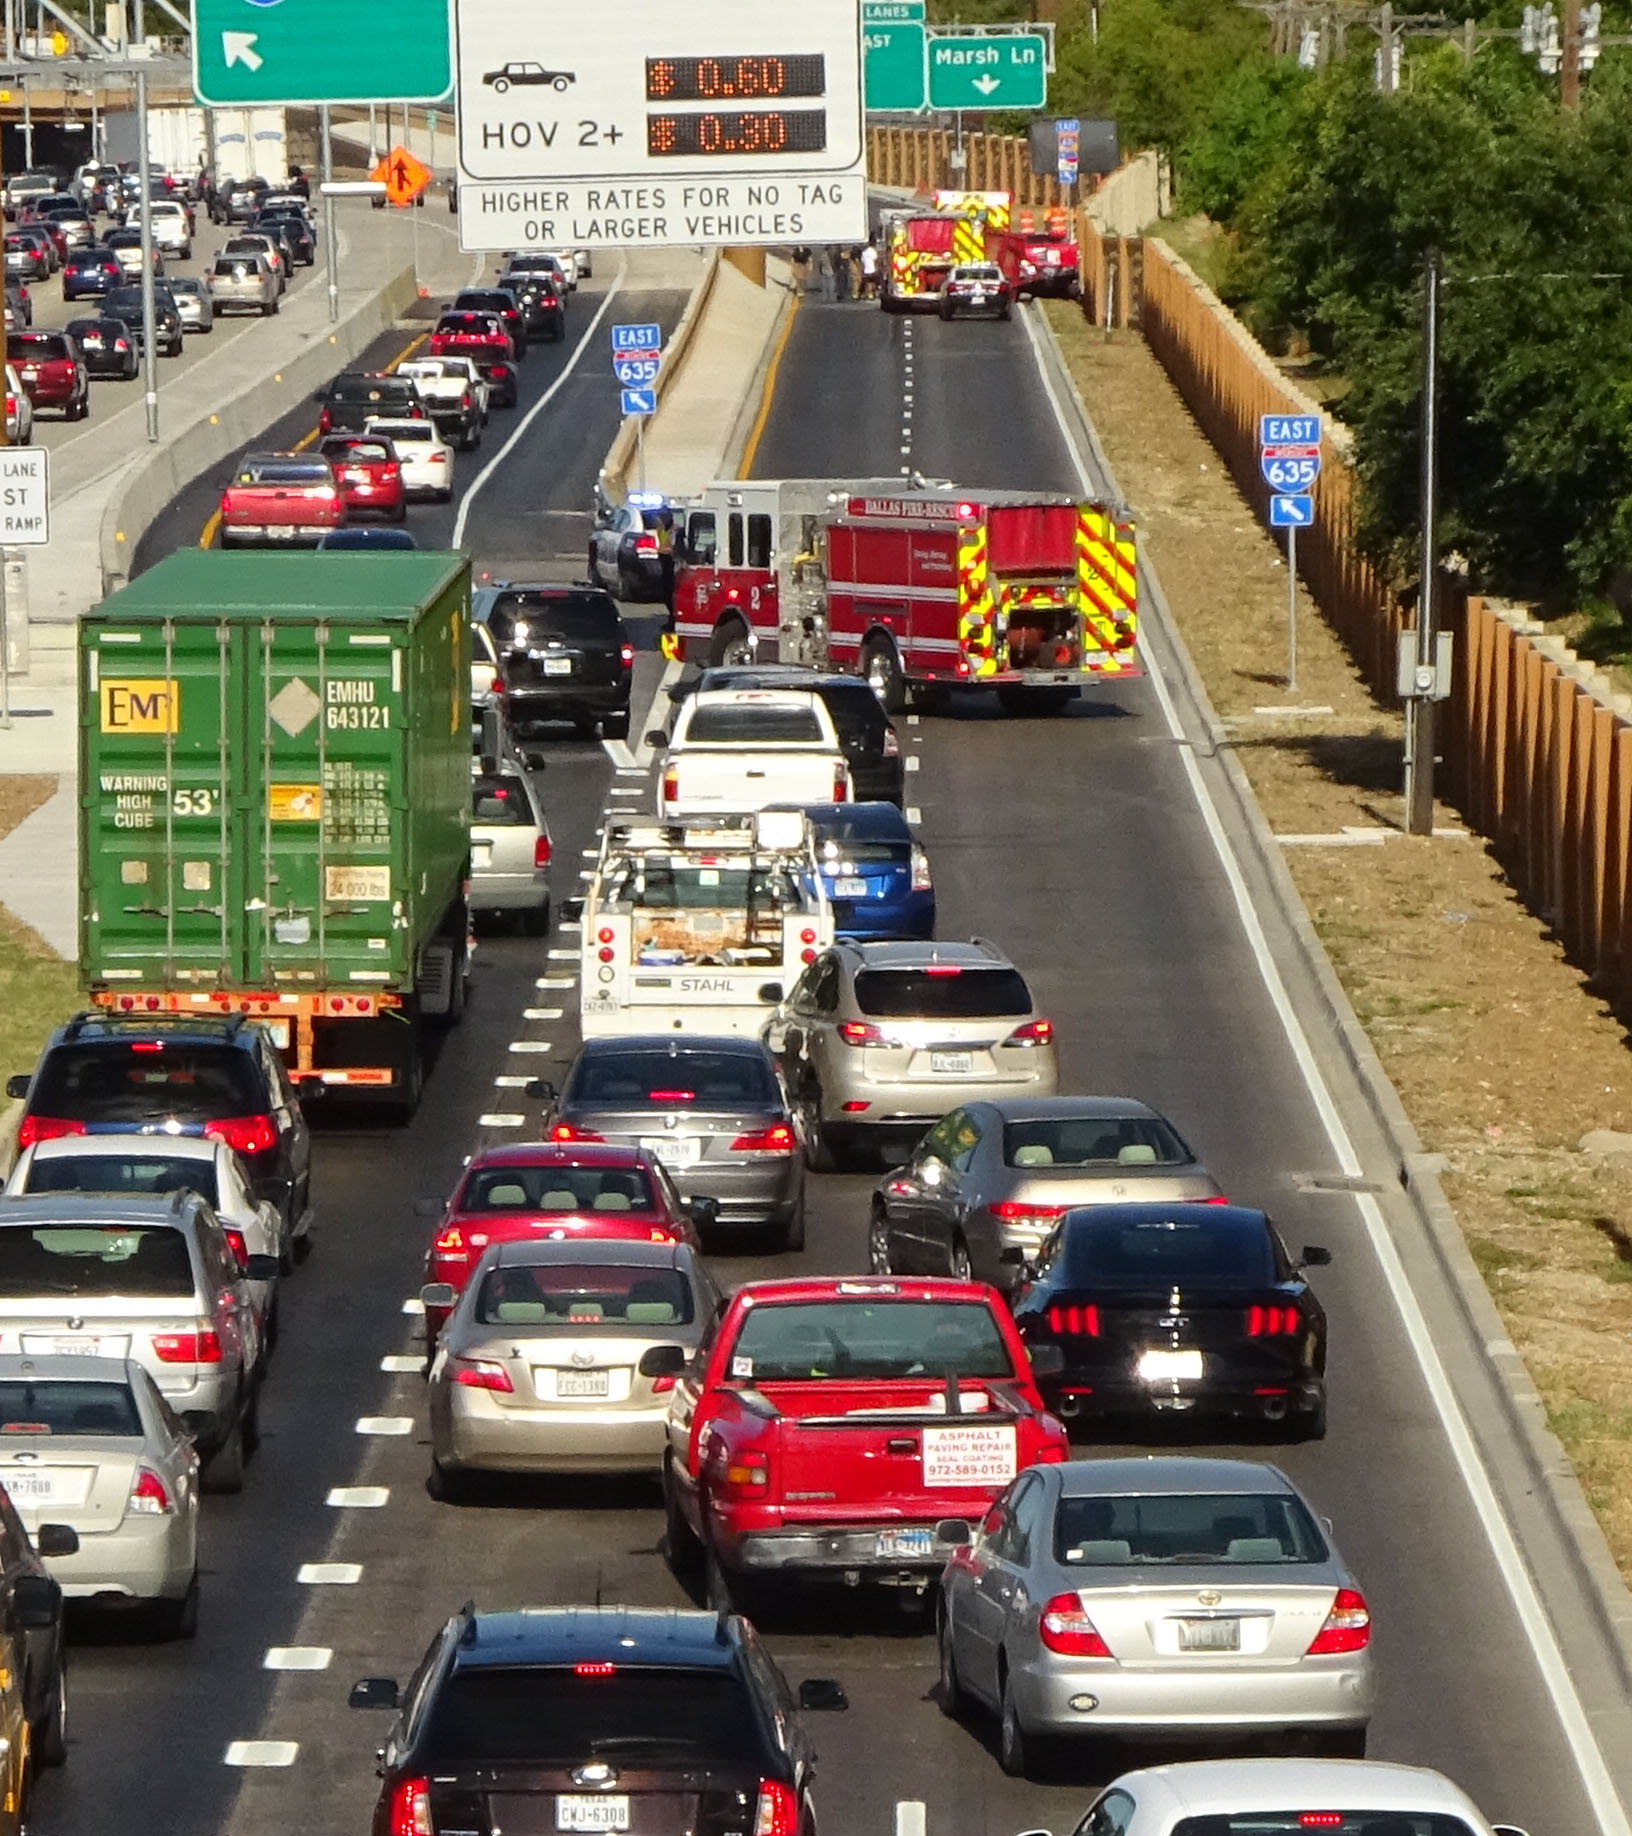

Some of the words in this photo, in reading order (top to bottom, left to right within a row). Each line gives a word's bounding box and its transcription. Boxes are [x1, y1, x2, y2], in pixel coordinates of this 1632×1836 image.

[866, 6, 911, 18] LANES
[863, 34, 892, 47] AST
[935, 46, 999, 65] Marsh
[1011, 47, 1035, 64] Ln
[650, 60, 675, 96] $
[697, 58, 784, 96] 0.60
[482, 122, 559, 149] HOV
[578, 120, 624, 147] 2+
[651, 116, 676, 151] $
[699, 113, 786, 151] 0.30
[482, 191, 569, 213] HIGHER
[588, 189, 666, 211] RATES
[683, 187, 729, 208] FOR
[748, 185, 779, 207] NO
[798, 184, 843, 205] TAG
[524, 219, 555, 241] OR
[573, 217, 668, 240] LARGER
[686, 214, 804, 237] VEHICLES
[619, 328, 652, 345] EAST
[620, 361, 656, 380] 635
[1269, 421, 1313, 440] EAST
[4, 463, 37, 477] LANE
[1269, 461, 1315, 483] 635
[865, 500, 901, 515] DALLAS
[5, 516, 42, 530] RAMP
[327, 681, 374, 703] EMHU
[327, 706, 389, 729] 643121
[100, 776, 167, 791] WARNING
[117, 795, 151, 809] HIGH
[114, 813, 154, 828] CUBE
[680, 979, 734, 992] STAHL
[939, 1431, 1001, 1440] ASPHALT
[928, 1443, 967, 1452] PAVING
[971, 1442, 1011, 1452] REPAIR
[928, 1464, 1011, 1475] 972-589-0152
